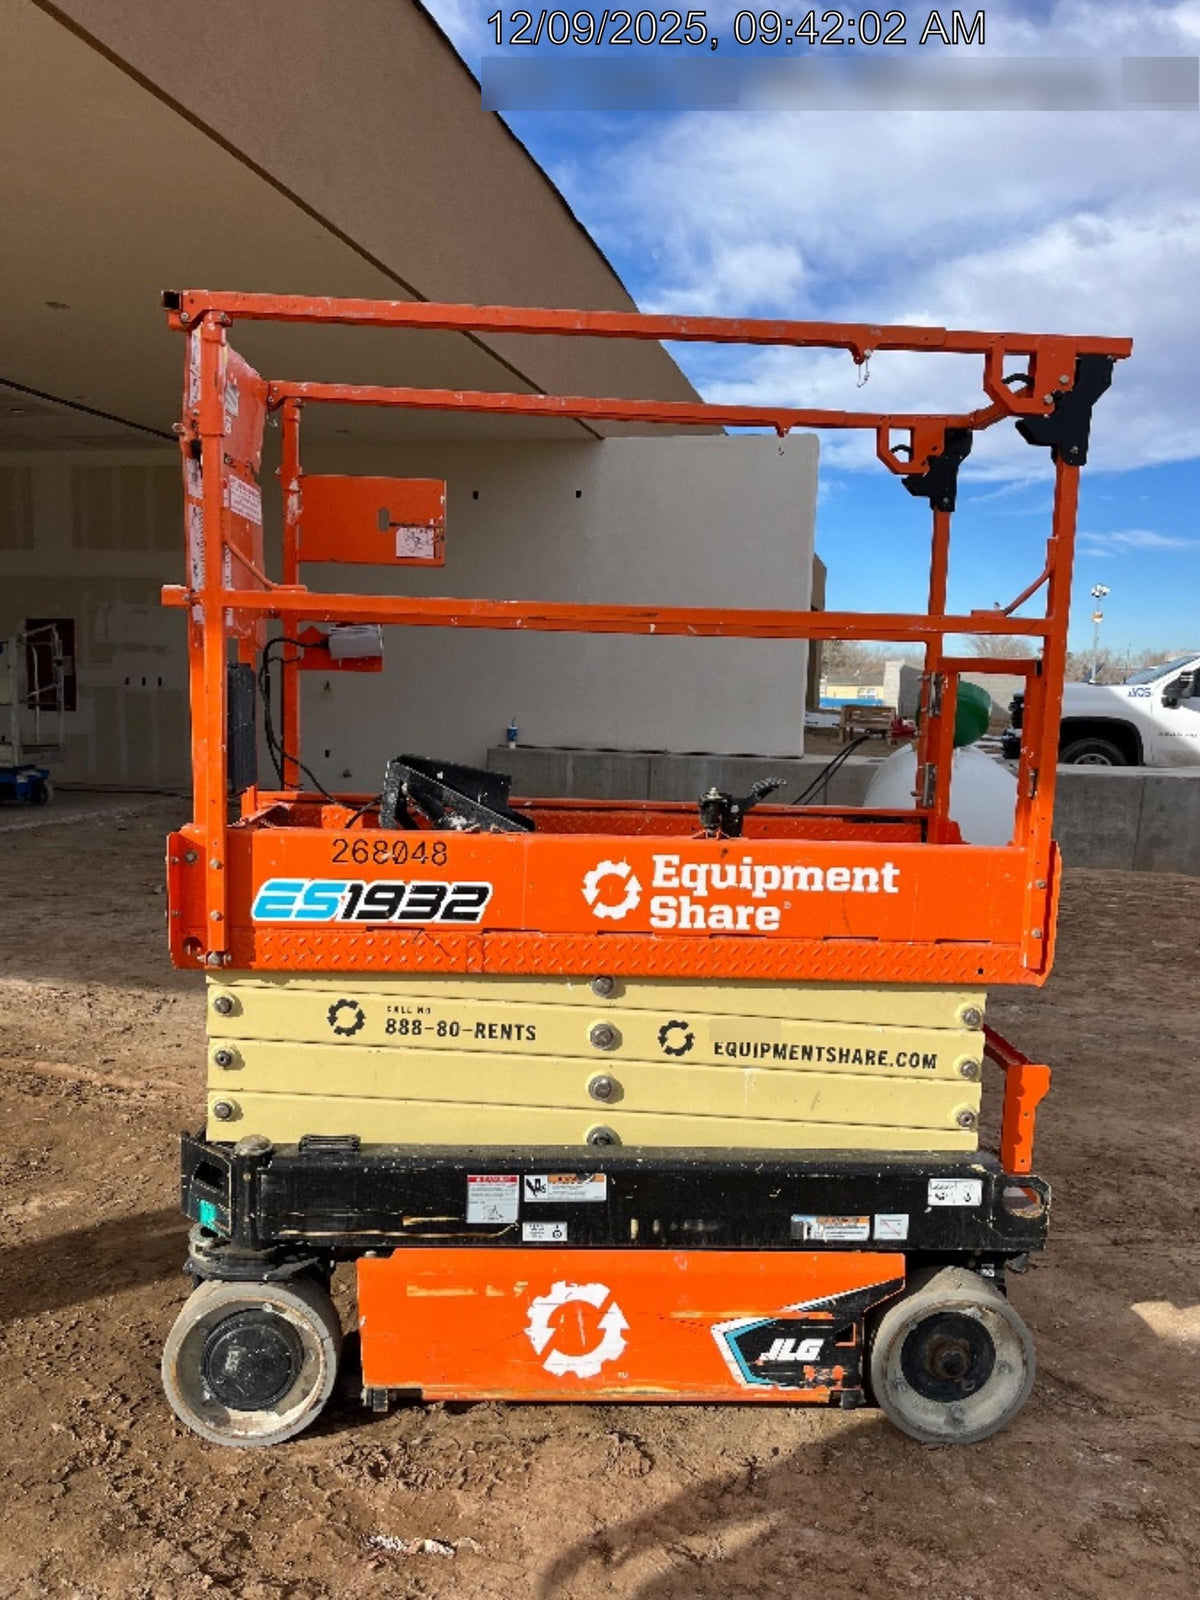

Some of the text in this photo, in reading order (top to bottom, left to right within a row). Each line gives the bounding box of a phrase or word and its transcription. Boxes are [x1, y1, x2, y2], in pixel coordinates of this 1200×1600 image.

[331, 838, 448, 867] 268048
[652, 854, 900, 898] Equipment
[252, 878, 493, 924] ES1932
[649, 896, 781, 931] Share
[385, 1018, 537, 1041] 888-80-RENTS
[714, 1041, 938, 1070] EQUIPMENTSHARE.COM
[760, 1337, 825, 1361] JLG
